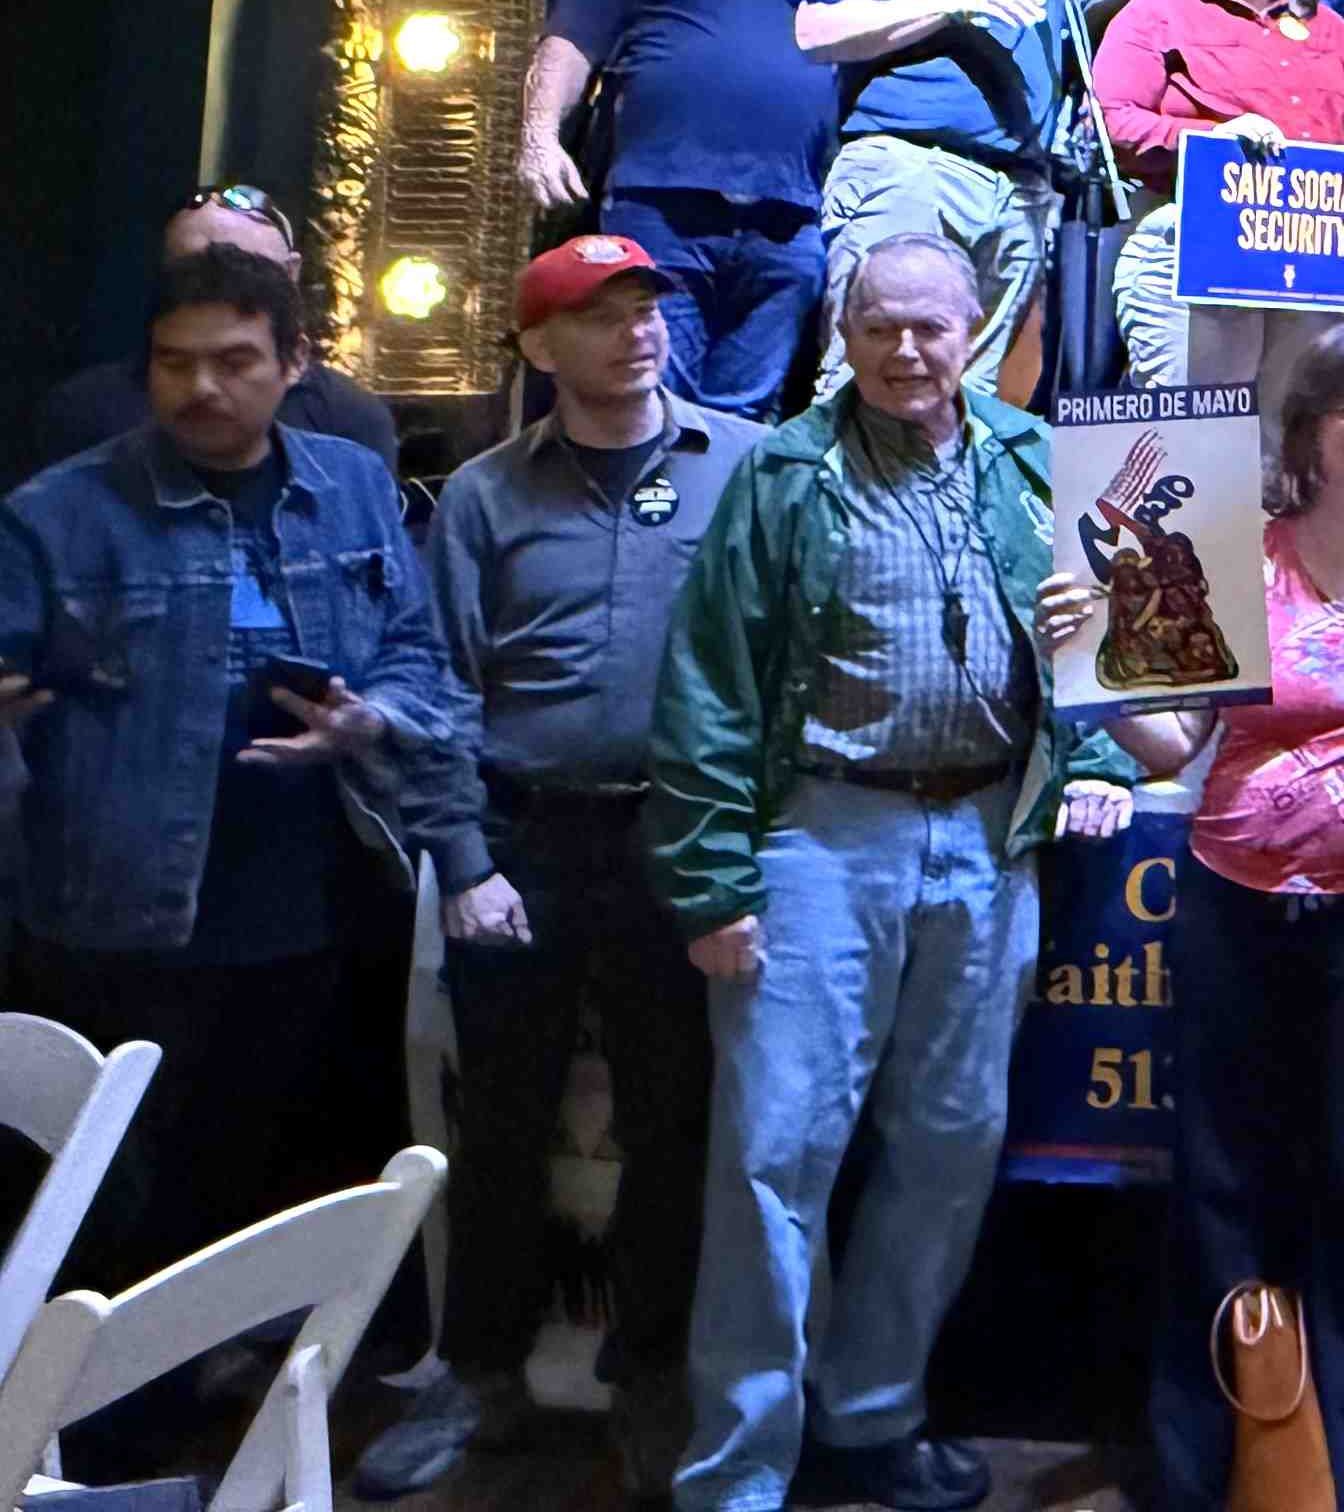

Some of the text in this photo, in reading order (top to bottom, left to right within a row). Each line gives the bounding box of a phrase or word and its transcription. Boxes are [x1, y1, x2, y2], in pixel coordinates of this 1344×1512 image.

[1220, 161, 1287, 208] SAVE
[1056, 386, 1252, 424] PRIMERO DE MAYO
[1041, 940, 1171, 1007] aith
